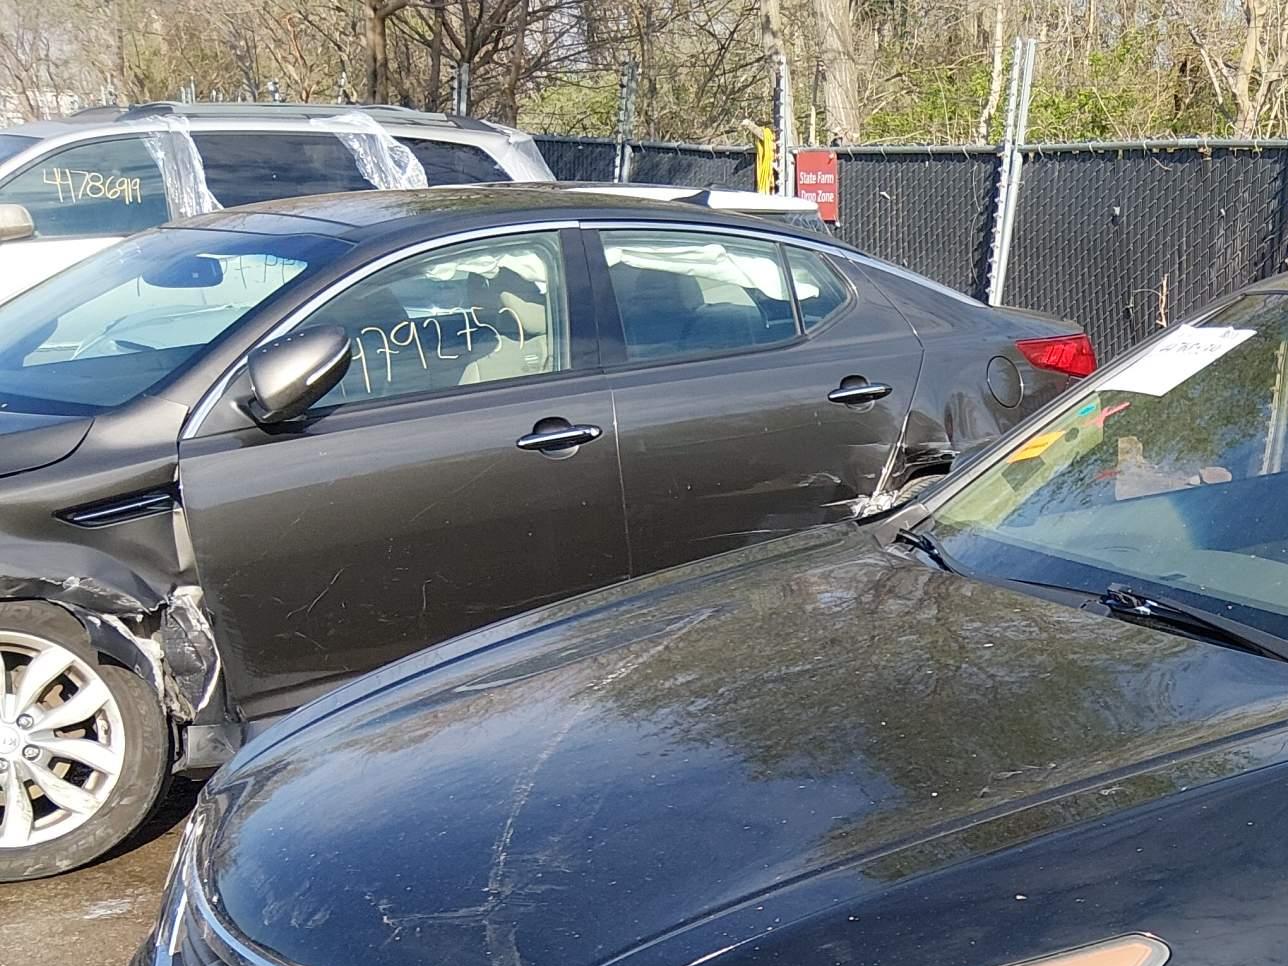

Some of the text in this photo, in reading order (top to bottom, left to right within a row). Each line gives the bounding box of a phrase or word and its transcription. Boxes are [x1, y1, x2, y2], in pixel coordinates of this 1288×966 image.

[800, 172, 834, 184] State Farm
[817, 190, 834, 203] Zone
